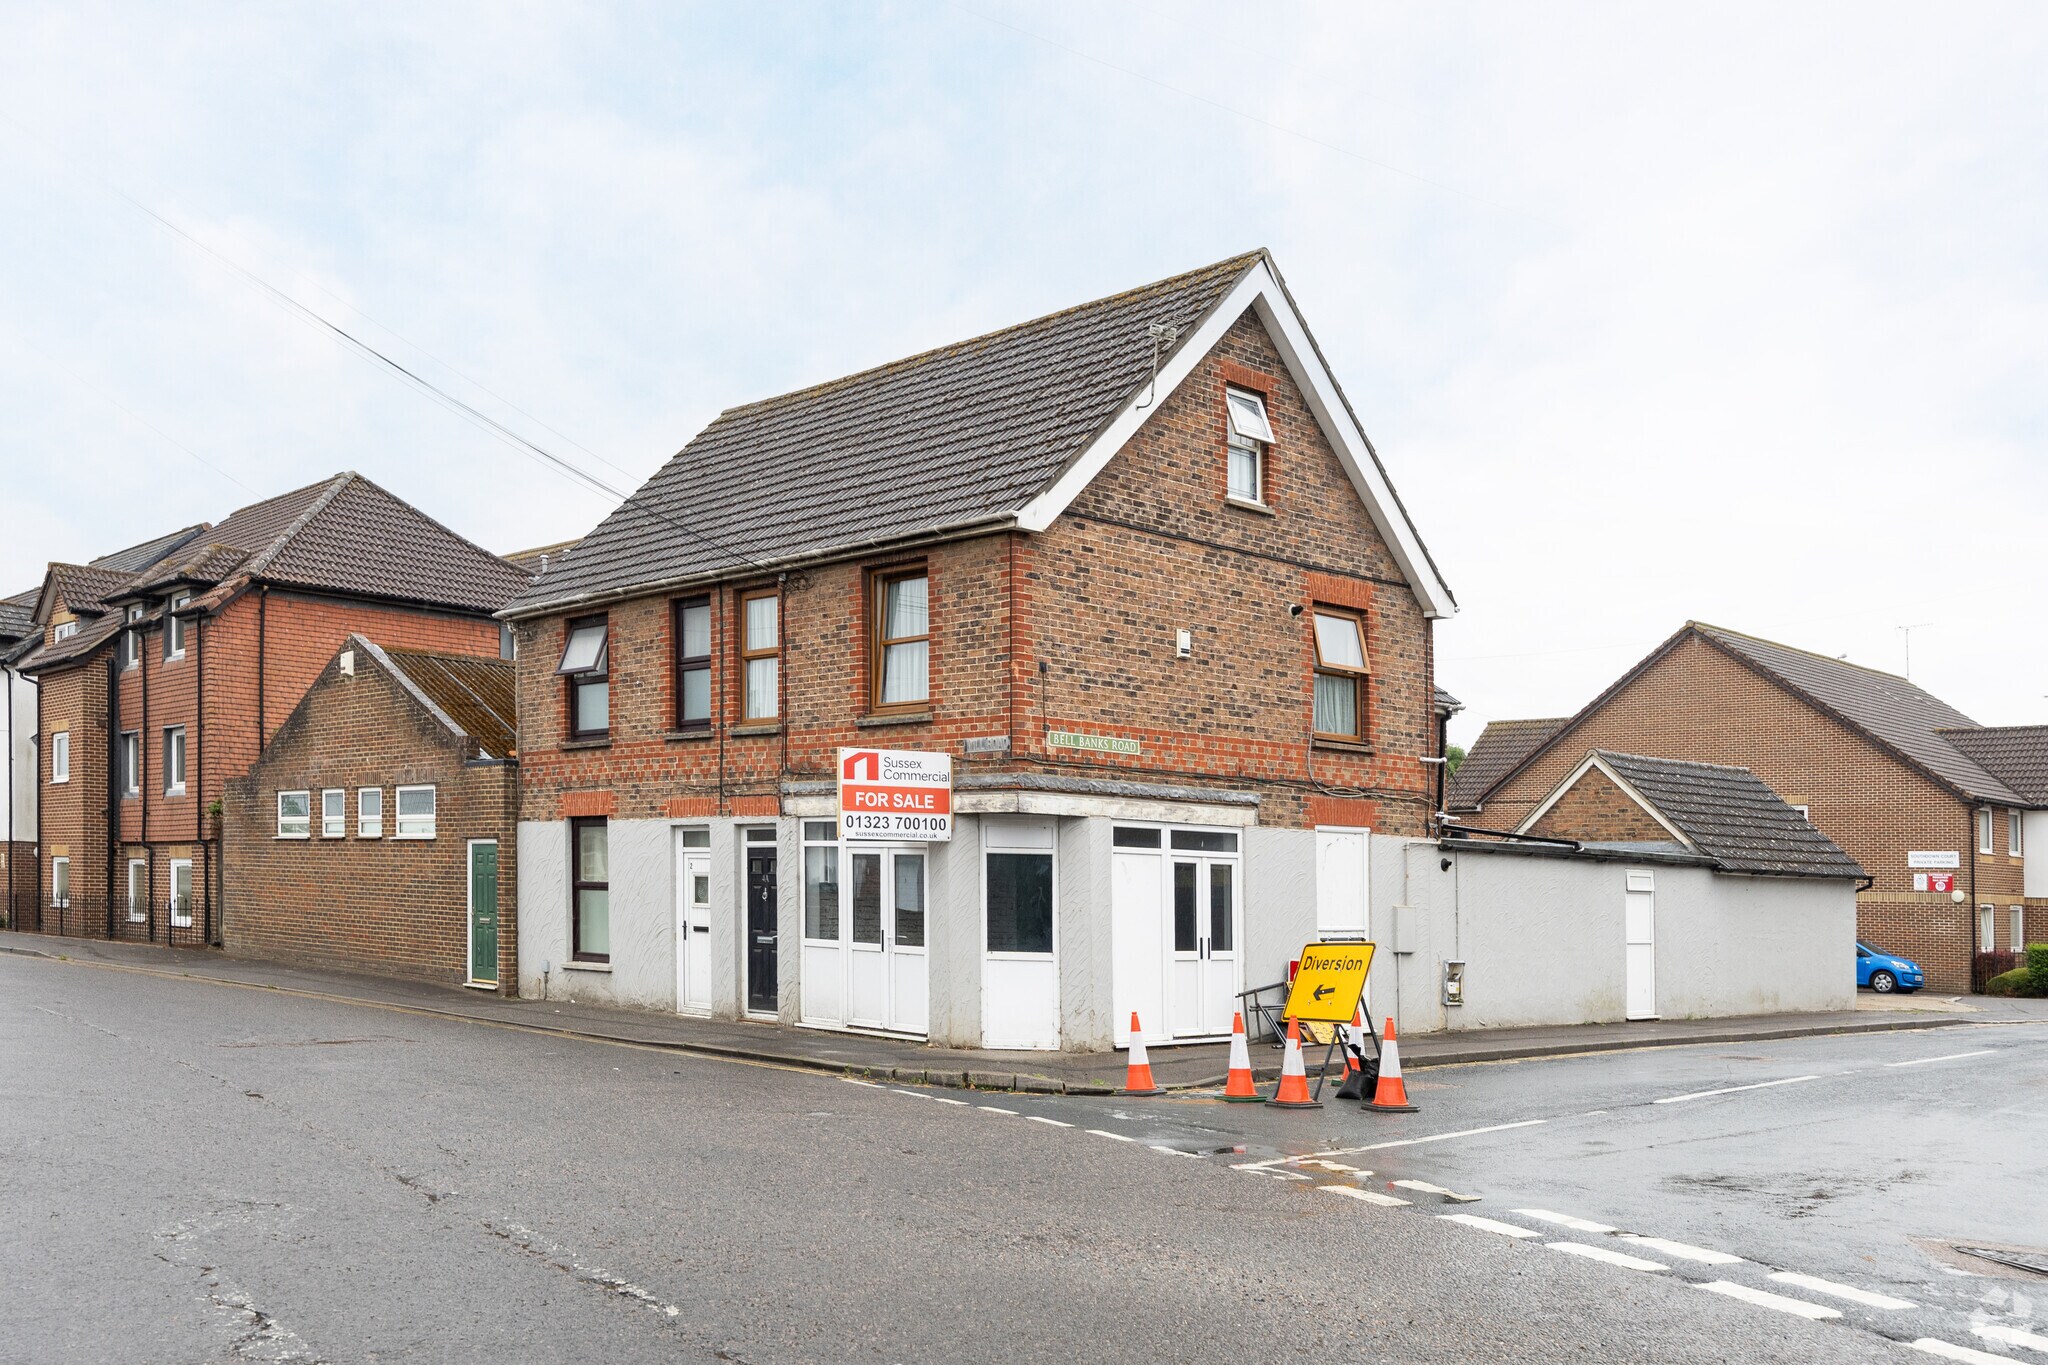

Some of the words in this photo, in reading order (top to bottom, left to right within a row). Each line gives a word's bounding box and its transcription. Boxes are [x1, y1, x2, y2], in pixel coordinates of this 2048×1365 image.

[1053, 733, 1076, 746] BELL
[1079, 736, 1109, 750] BANKS
[1111, 740, 1137, 752] ROAD
[883, 756, 922, 769] Sussex
[883, 769, 950, 782] Commercial
[855, 791, 889, 808] FOR
[893, 793, 935, 809] SALE
[846, 815, 890, 829] 01323
[895, 817, 946, 831] 700100
[855, 831, 938, 839] sussexcommercial.co.uk
[1303, 955, 1363, 970] Diversion
